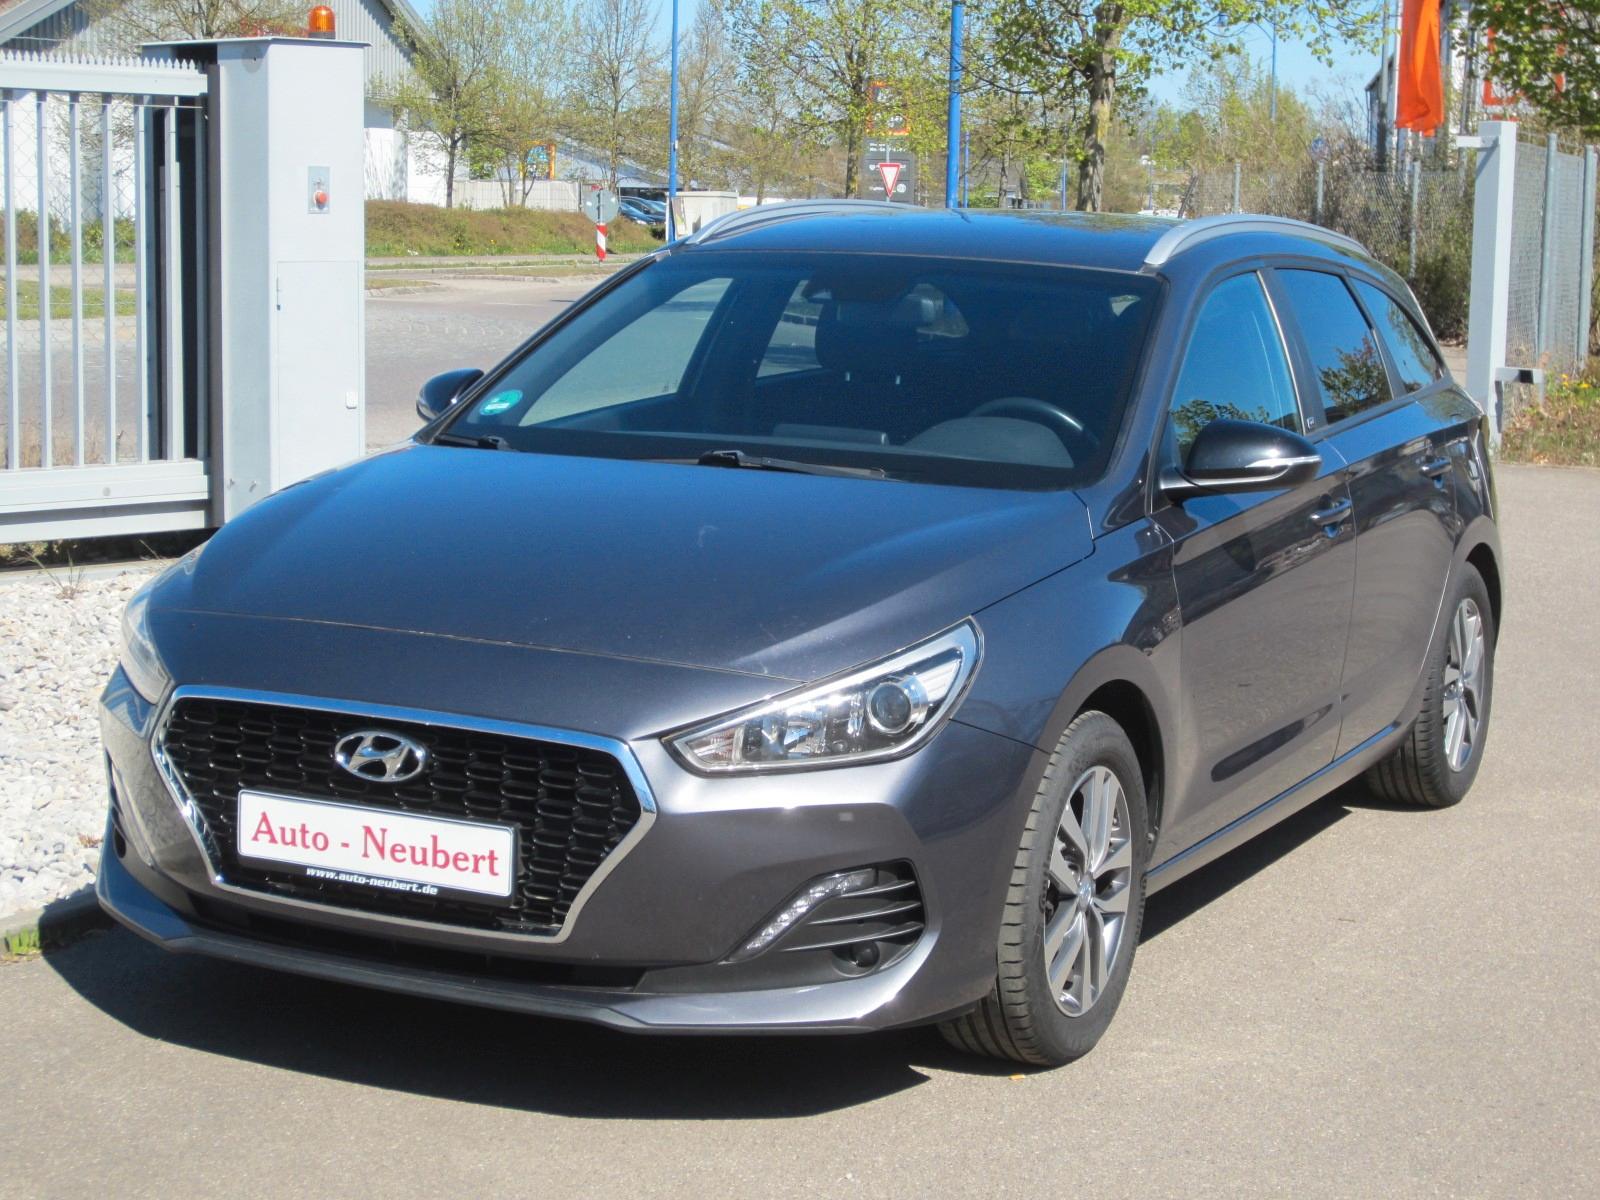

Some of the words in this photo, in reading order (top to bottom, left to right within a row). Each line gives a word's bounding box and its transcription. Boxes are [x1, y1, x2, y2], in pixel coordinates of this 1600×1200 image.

[251, 811, 329, 852] Auto
[340, 841, 350, 849] -
[361, 825, 499, 877] Neubert
[306, 867, 438, 895] www.auto-neubert.de
